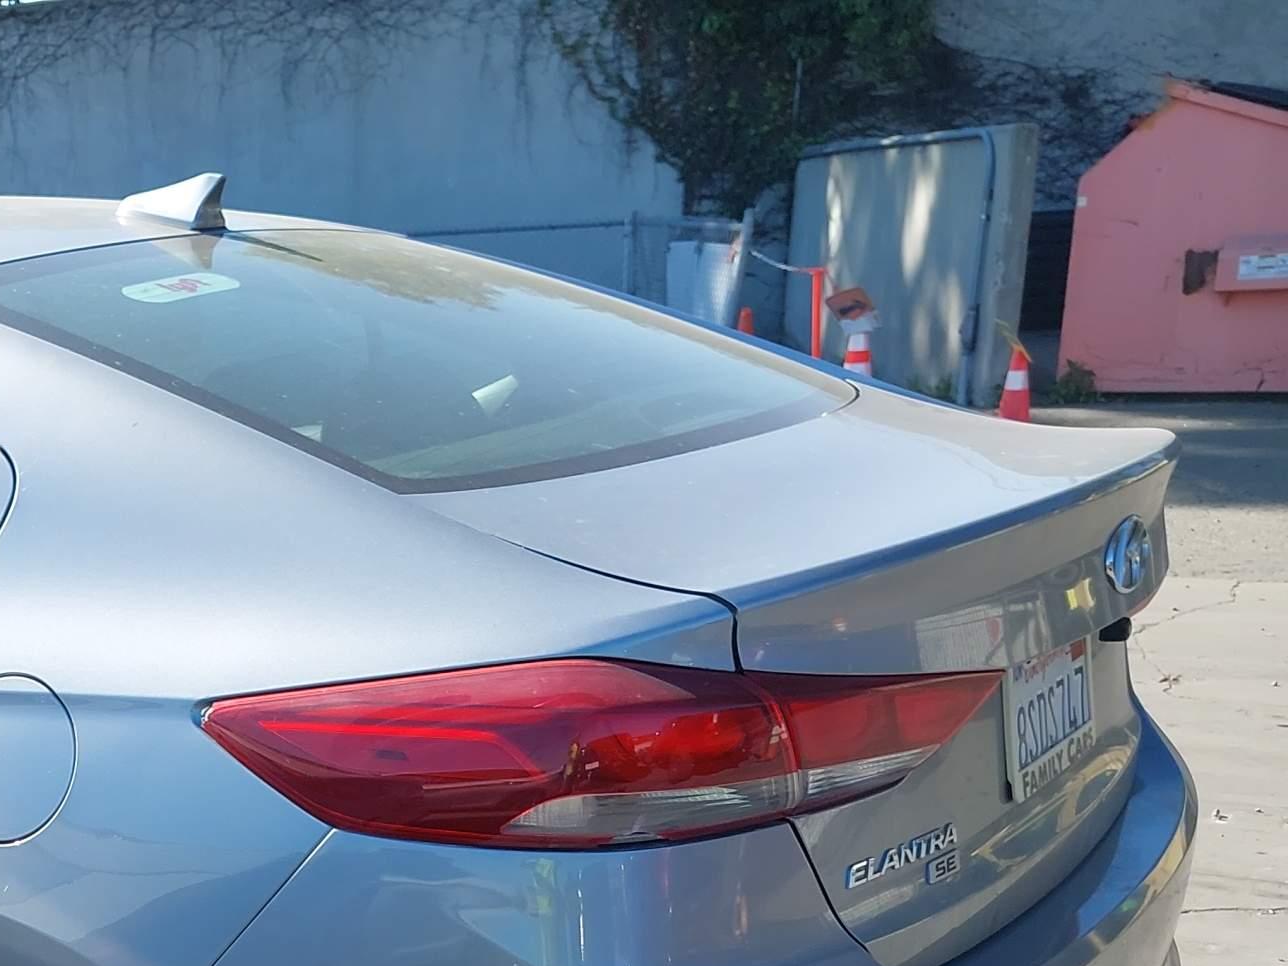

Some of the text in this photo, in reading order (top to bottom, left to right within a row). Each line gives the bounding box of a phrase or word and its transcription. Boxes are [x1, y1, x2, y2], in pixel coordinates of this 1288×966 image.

[1017, 666, 1086, 769] 8SDS747
[1022, 749, 1063, 798] FAMILY
[846, 822, 958, 889] ELANTRA
[935, 854, 958, 879] SE
